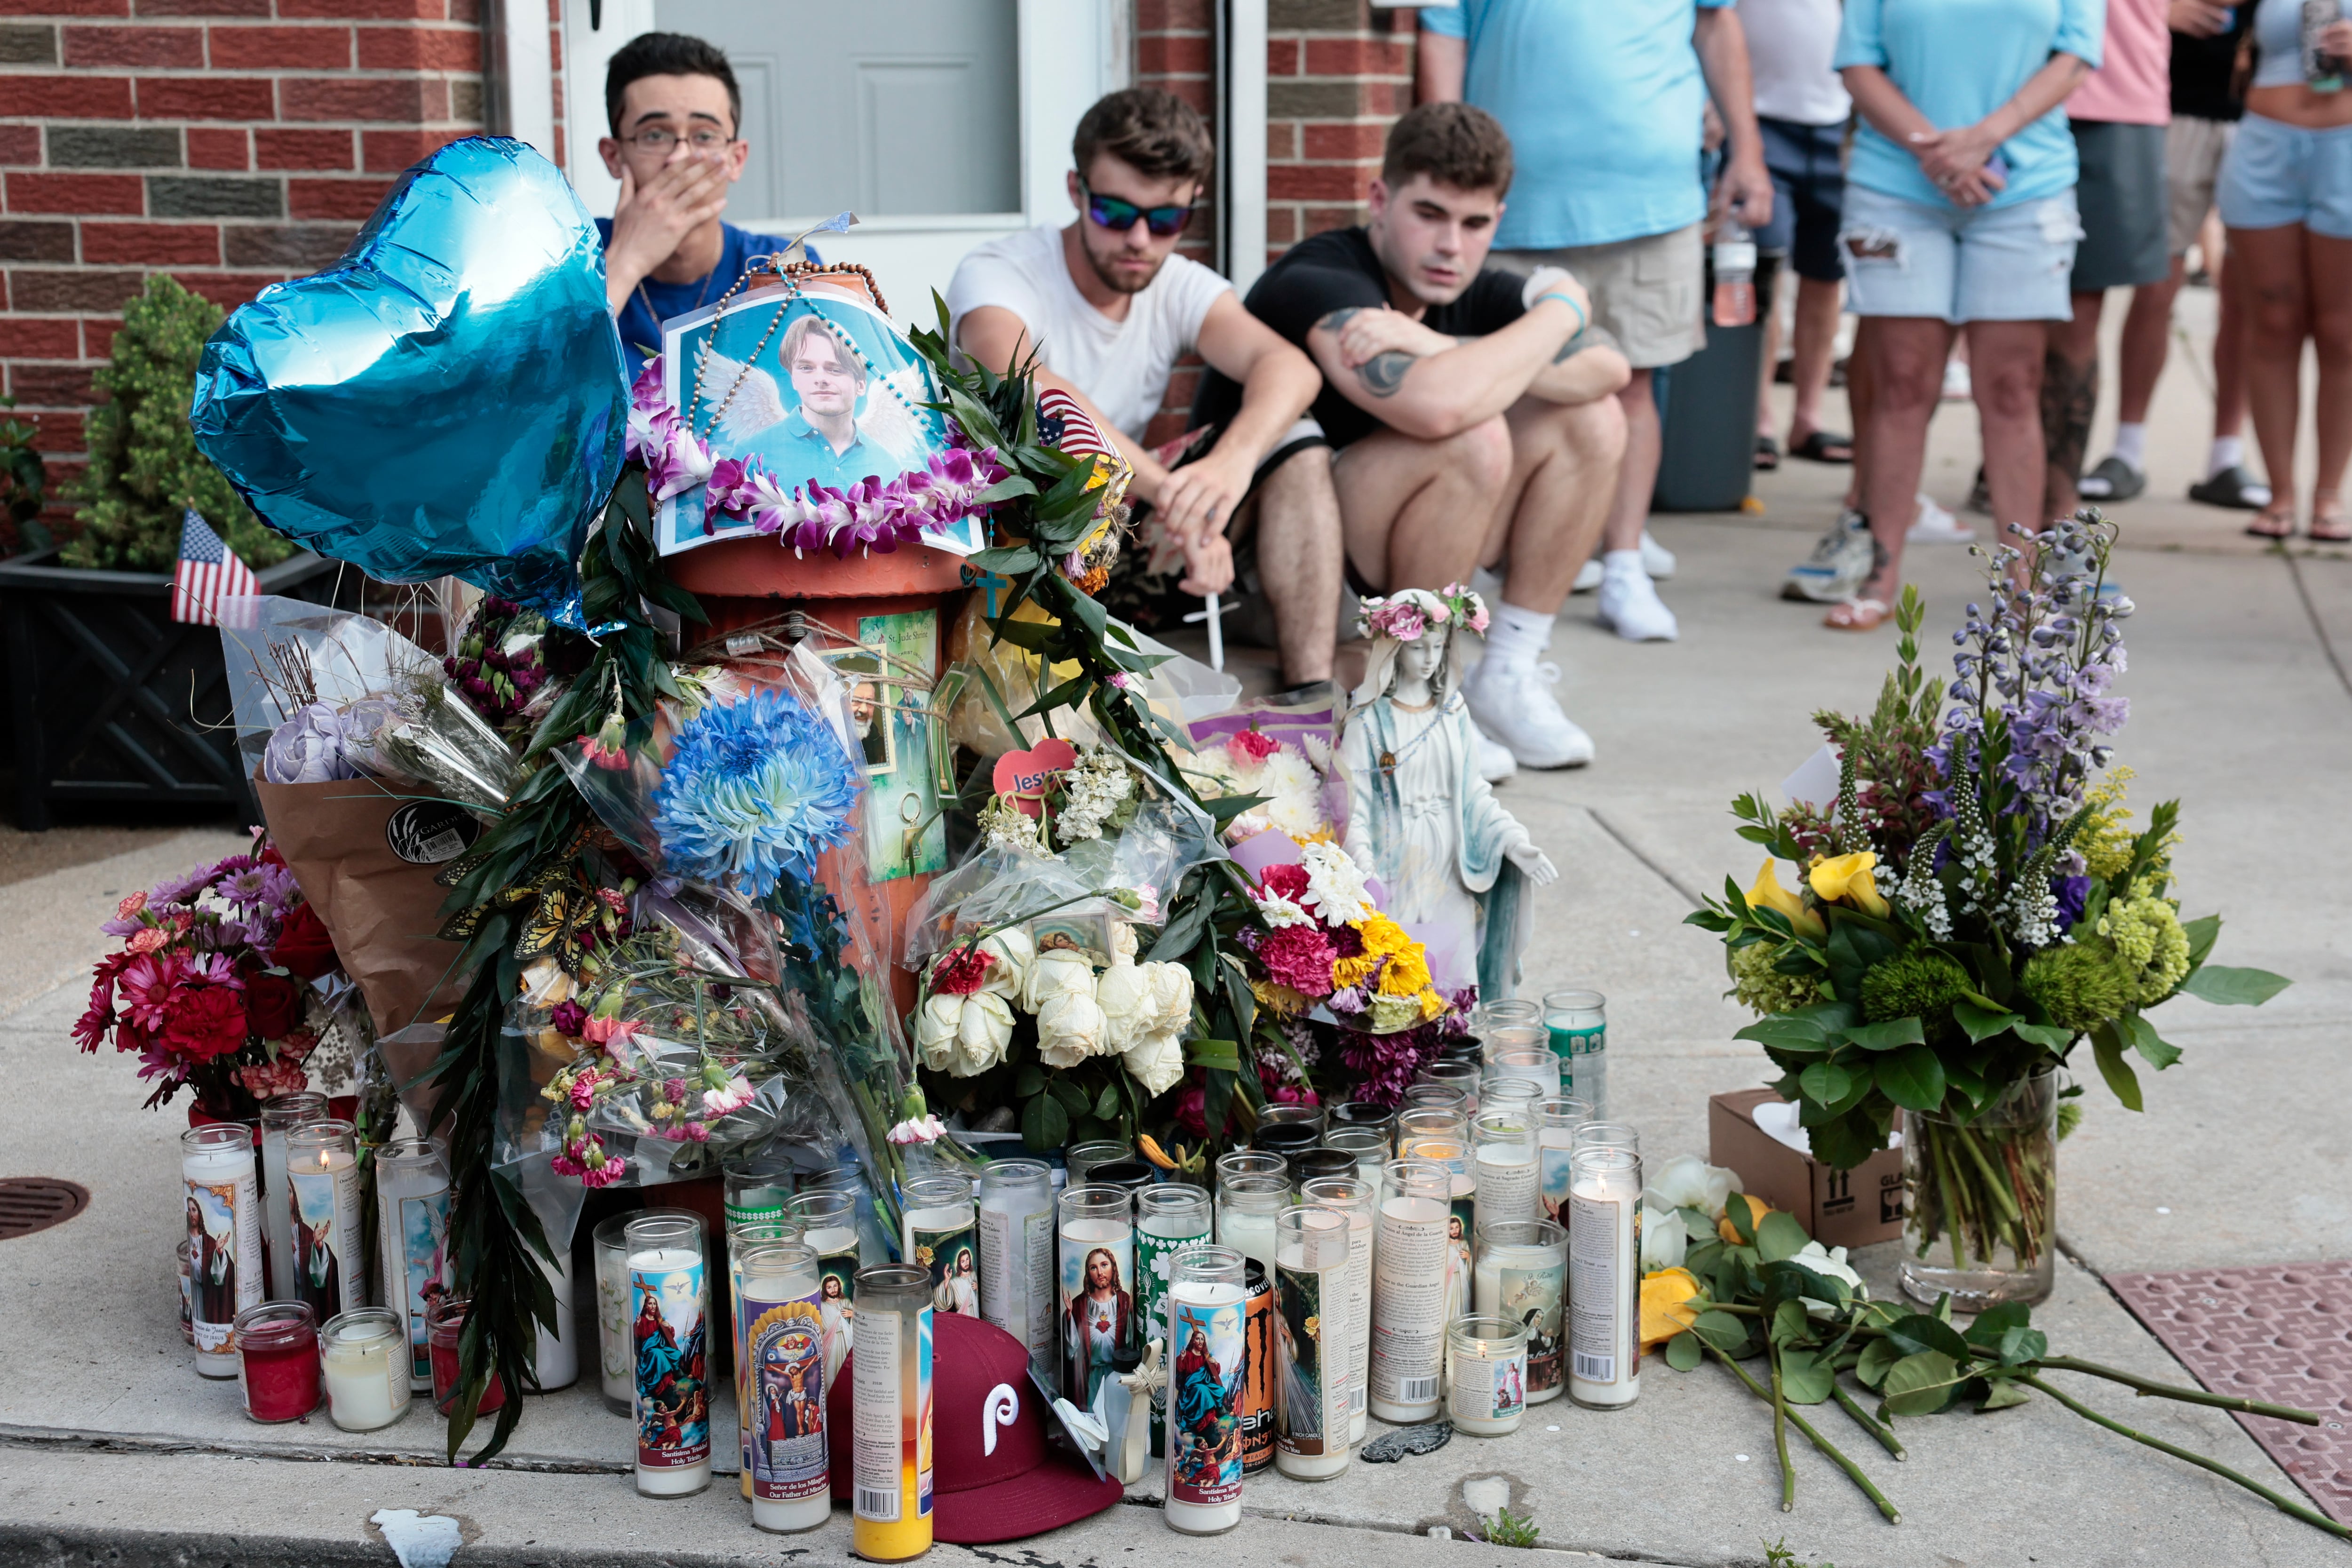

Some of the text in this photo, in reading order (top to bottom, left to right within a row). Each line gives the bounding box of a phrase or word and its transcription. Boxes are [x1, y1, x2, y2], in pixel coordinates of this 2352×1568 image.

[898, 632, 912, 644] Jude
[913, 630, 928, 639] Shrine
[420, 812, 471, 834] GARDEN
[1382, 1224, 1395, 1233] Oración
[1138, 1307, 1144, 1315] TO
[691, 1441, 707, 1453] Trinidad
[1246, 1450, 1266, 1461] PEACH
[807, 1475, 826, 1486] Milagros
[810, 1483, 826, 1494] Miracles
[1223, 1492, 1237, 1501] Trinity
